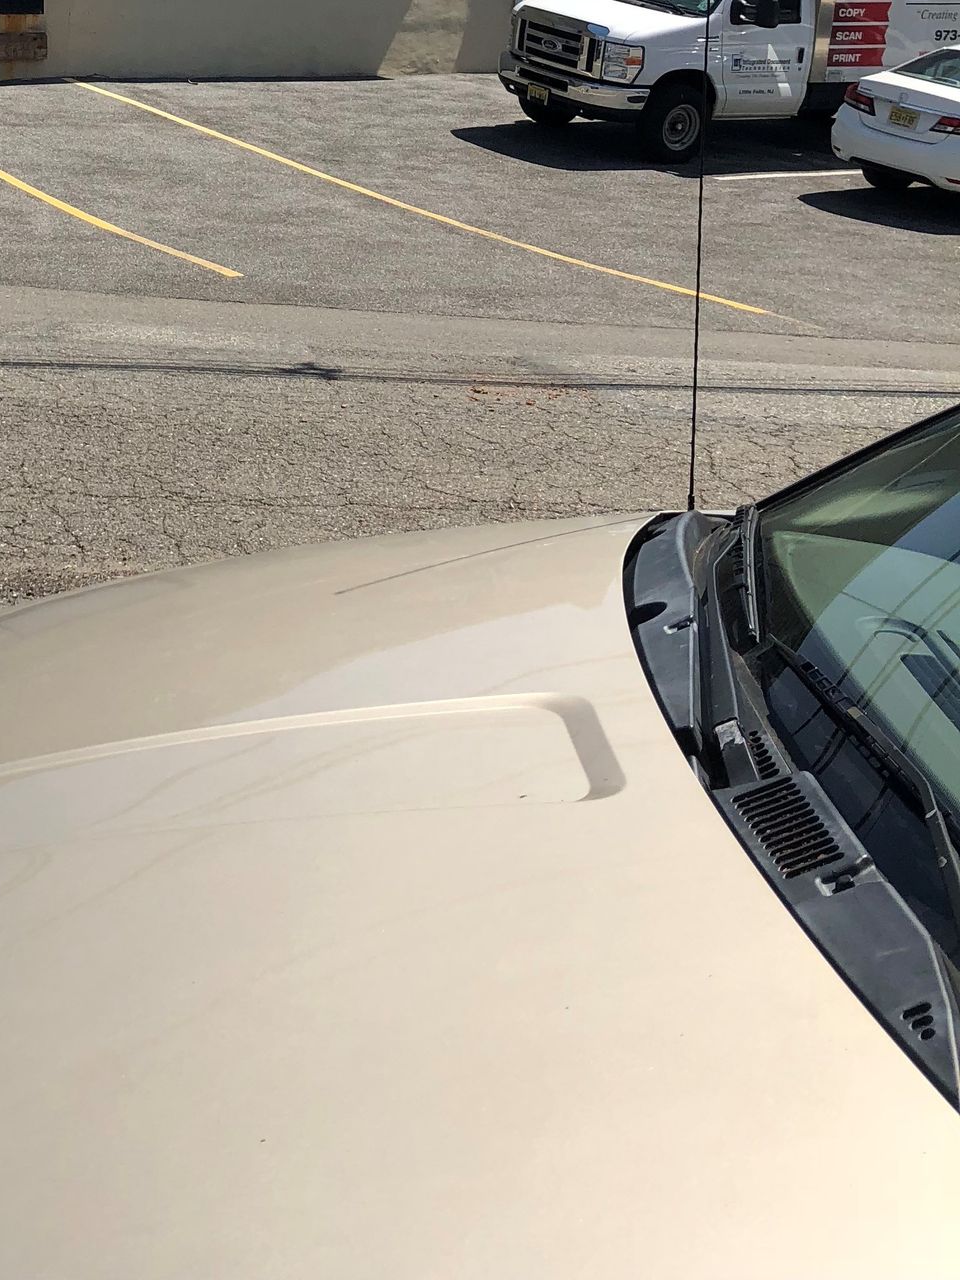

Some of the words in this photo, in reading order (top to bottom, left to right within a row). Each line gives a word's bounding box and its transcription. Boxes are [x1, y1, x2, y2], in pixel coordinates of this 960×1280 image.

[839, 8, 866, 17] COPY
[836, 32, 863, 40] SCAN
[934, 29, 960, 41] 973-
[832, 54, 862, 63] PRINT
